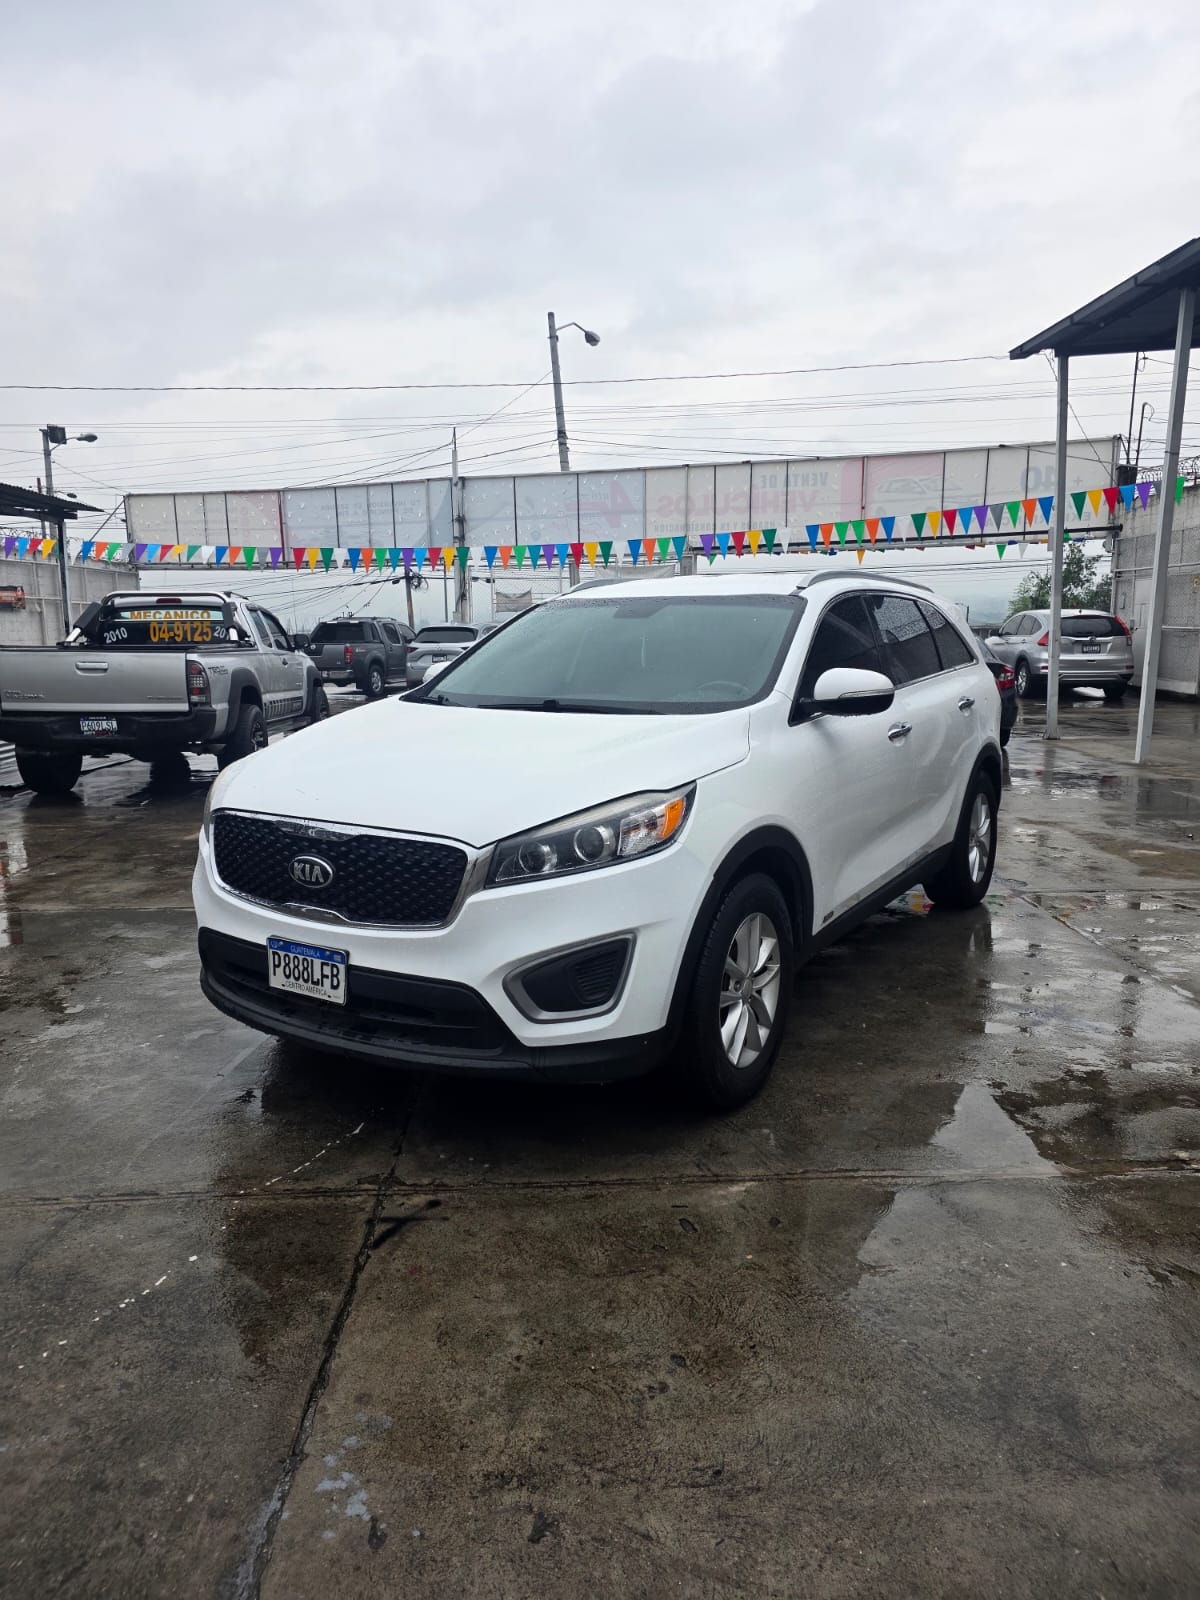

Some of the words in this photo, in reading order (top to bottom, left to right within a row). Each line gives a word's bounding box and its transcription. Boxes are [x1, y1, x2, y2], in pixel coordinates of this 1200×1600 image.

[129, 610, 211, 620] MECANICO
[103, 627, 128, 644] 2010
[150, 621, 212, 643] 04-9125
[293, 861, 325, 883] KIA
[290, 944, 321, 958] GUATEMALA
[271, 950, 340, 990] P888LFB
[285, 981, 306, 992] CENTRO
[306, 985, 328, 997] AMERICA
